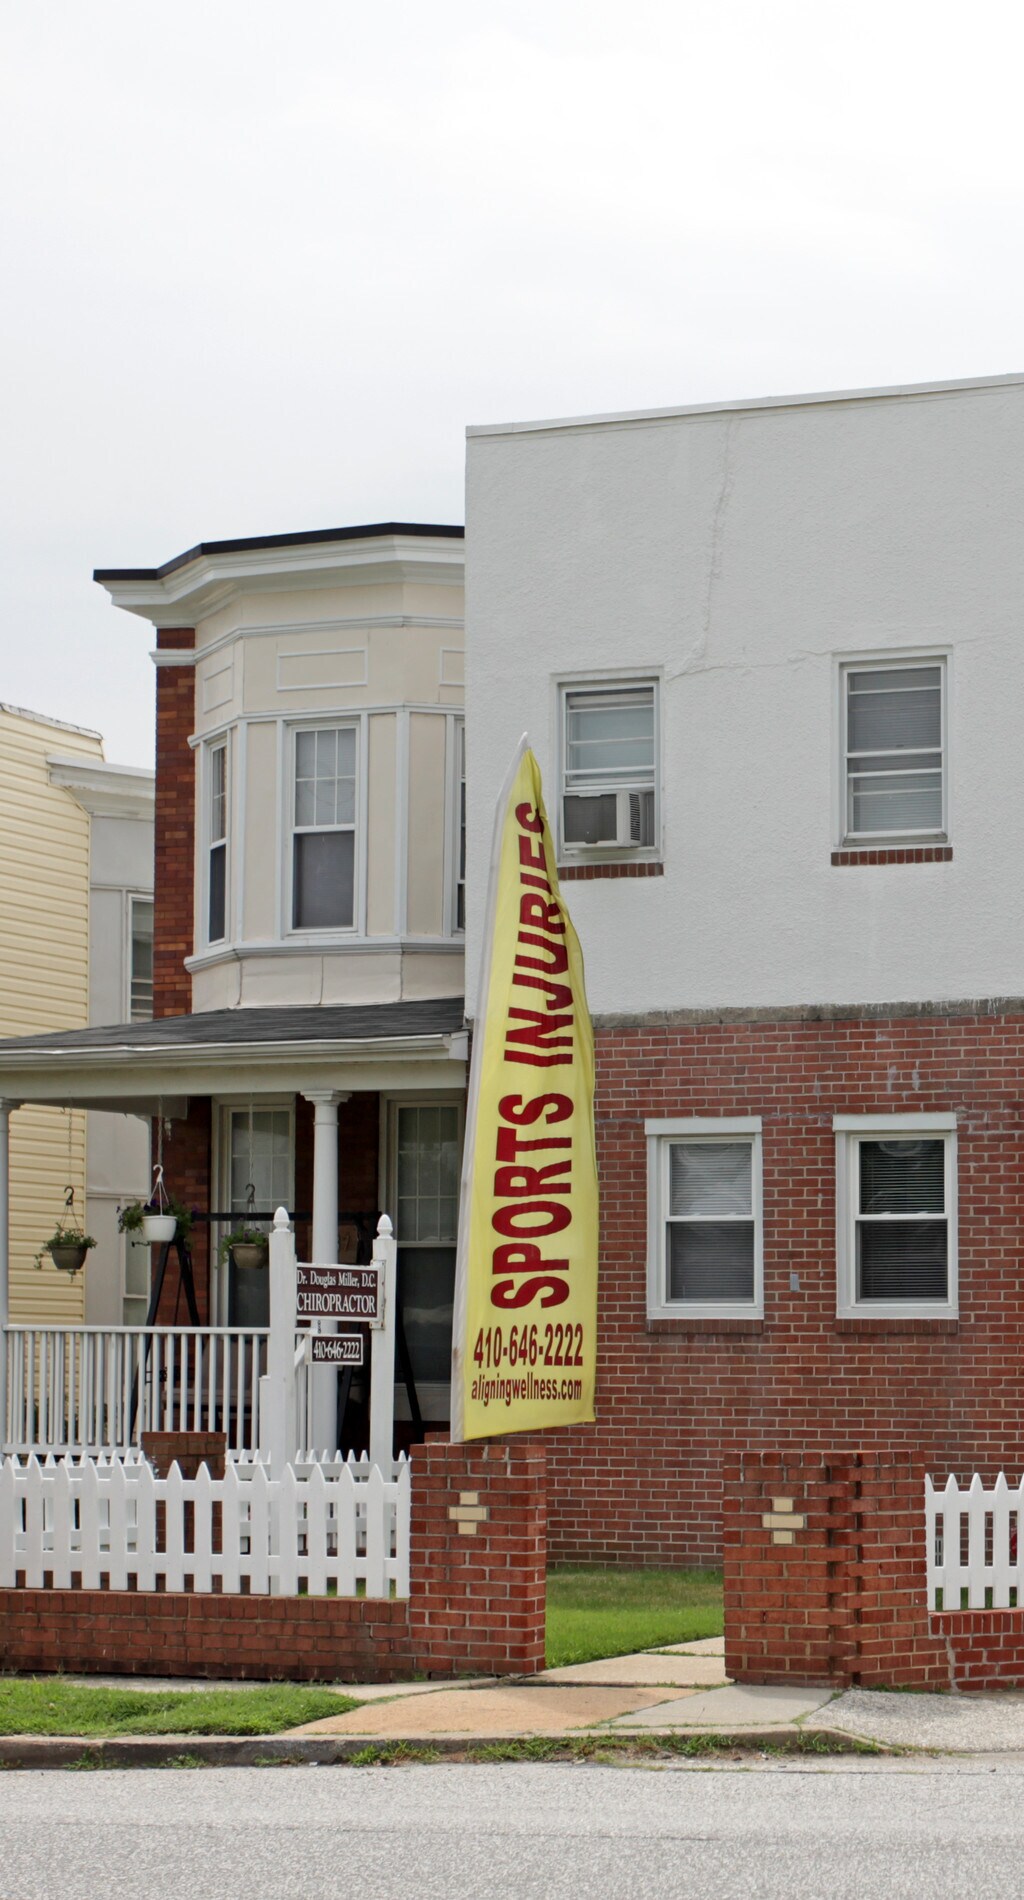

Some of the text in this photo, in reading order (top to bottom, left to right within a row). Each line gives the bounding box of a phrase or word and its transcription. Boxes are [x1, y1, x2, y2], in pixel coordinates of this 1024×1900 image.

[490, 802, 574, 1309] SPORTS INJURIES
[297, 1270, 376, 1289] Dr. Douglas Miller, D.C.
[297, 1292, 376, 1313] CHIROPRACTOR
[313, 1340, 360, 1359] 410-646-2222
[474, 1323, 583, 1369] 410-646-2222
[471, 1372, 582, 1407] aligningwellness.com
